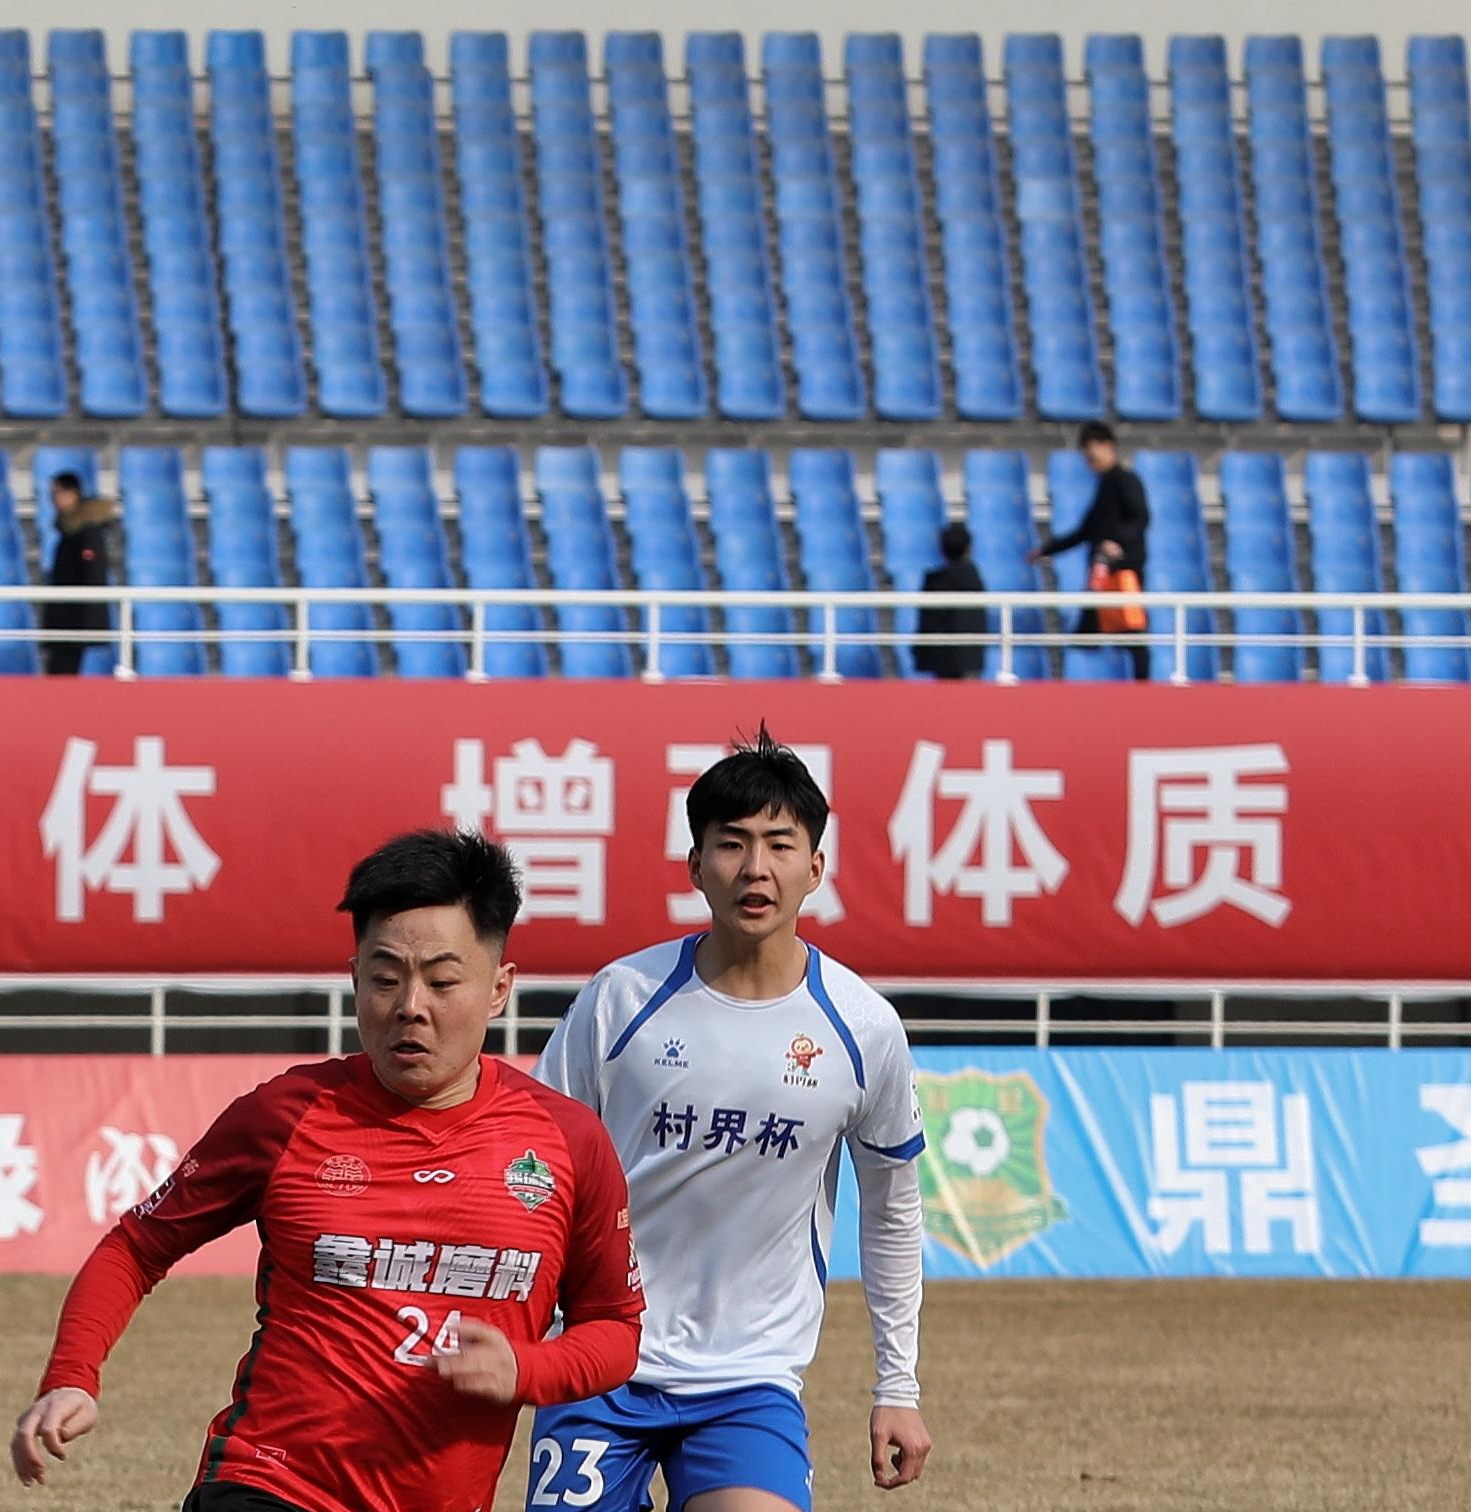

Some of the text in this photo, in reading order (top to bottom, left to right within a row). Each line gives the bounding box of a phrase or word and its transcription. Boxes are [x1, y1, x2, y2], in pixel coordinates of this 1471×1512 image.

[653, 1102, 805, 1160] 村界杯
[531, 1437, 610, 1507] 23
